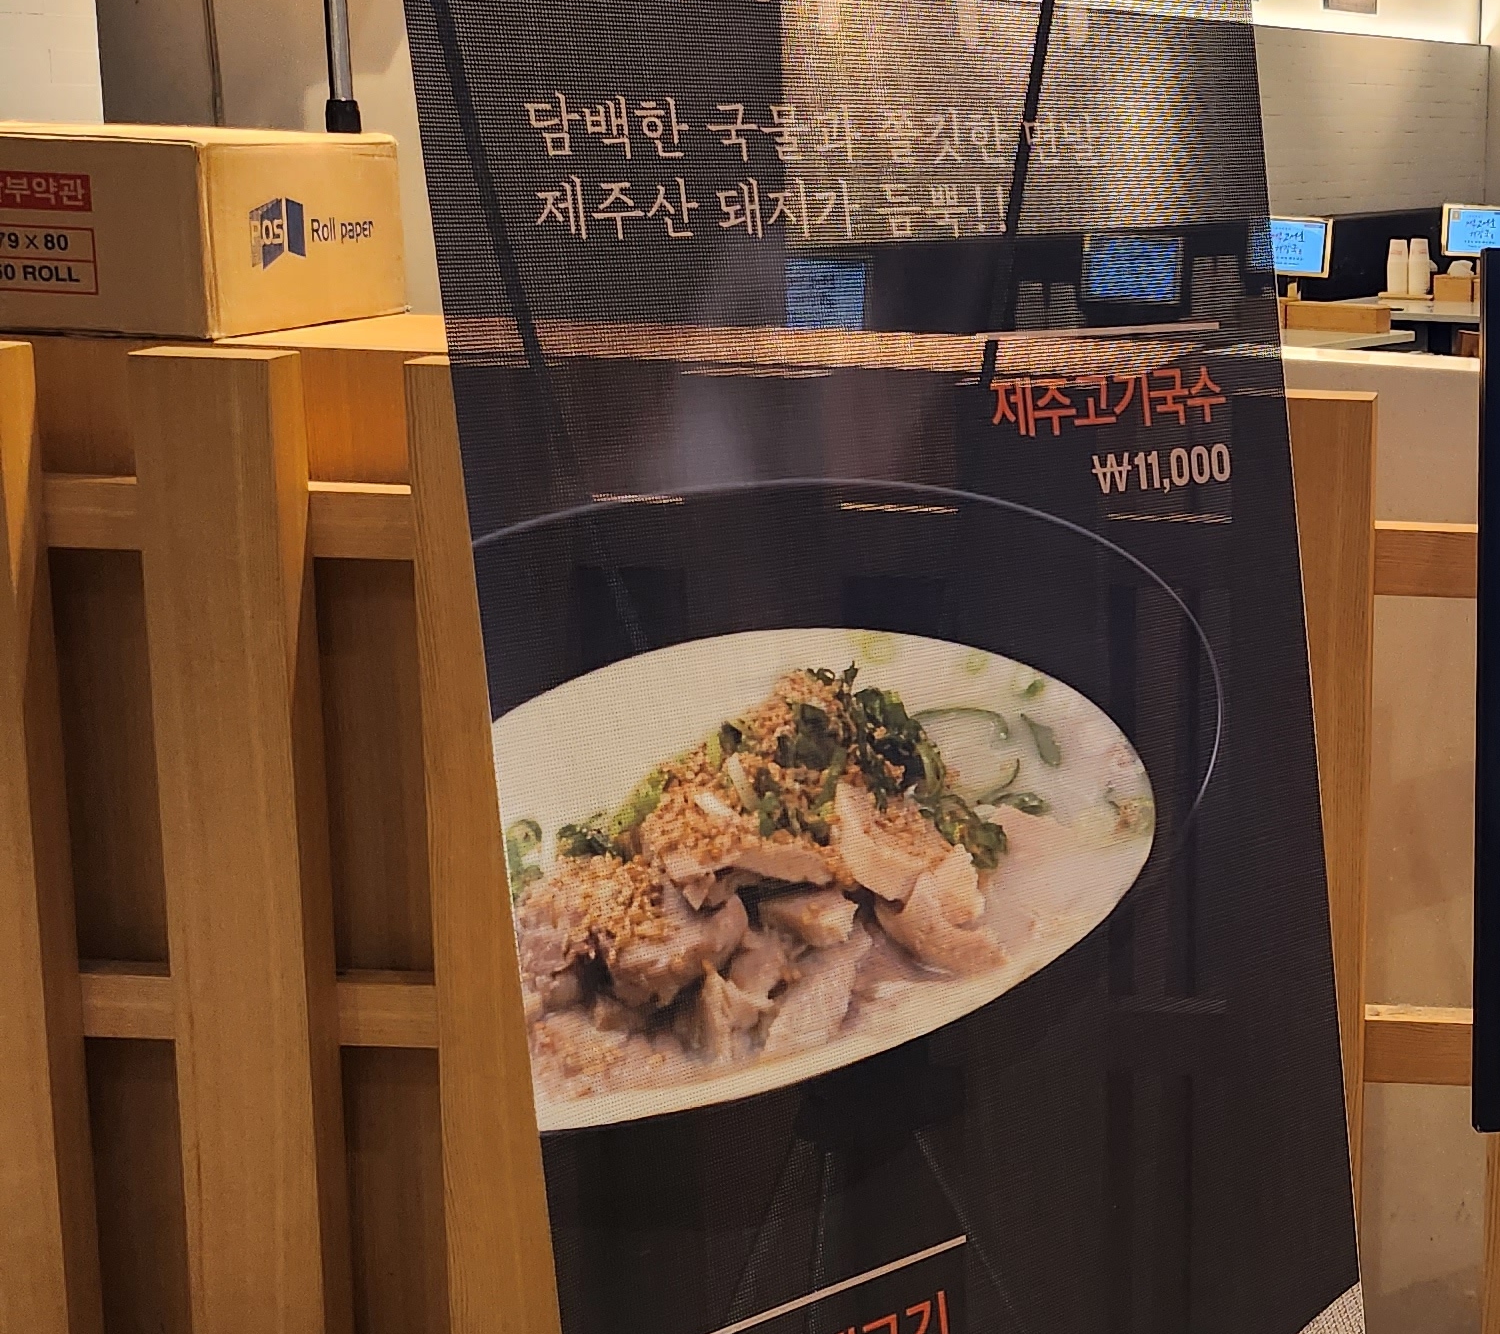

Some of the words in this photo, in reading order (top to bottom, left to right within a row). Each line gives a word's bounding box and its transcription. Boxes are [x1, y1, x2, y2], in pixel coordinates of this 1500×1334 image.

[524, 92, 689, 161] 담백한
[705, 102, 861, 162] 국물과
[0, 177, 84, 205] 부약관
[536, 175, 699, 239] 제주산
[718, 177, 861, 239] 돼지가
[878, 181, 1009, 239] 듬뿍!!
[44, 233, 68, 251] 80
[310, 217, 336, 242] Roll
[341, 219, 374, 243] paper
[0, 264, 15, 280] 0
[22, 265, 80, 282] ROLL
[990, 366, 1226, 437] 제주고기국수
[1092, 443, 1230, 493] ₩11,000
